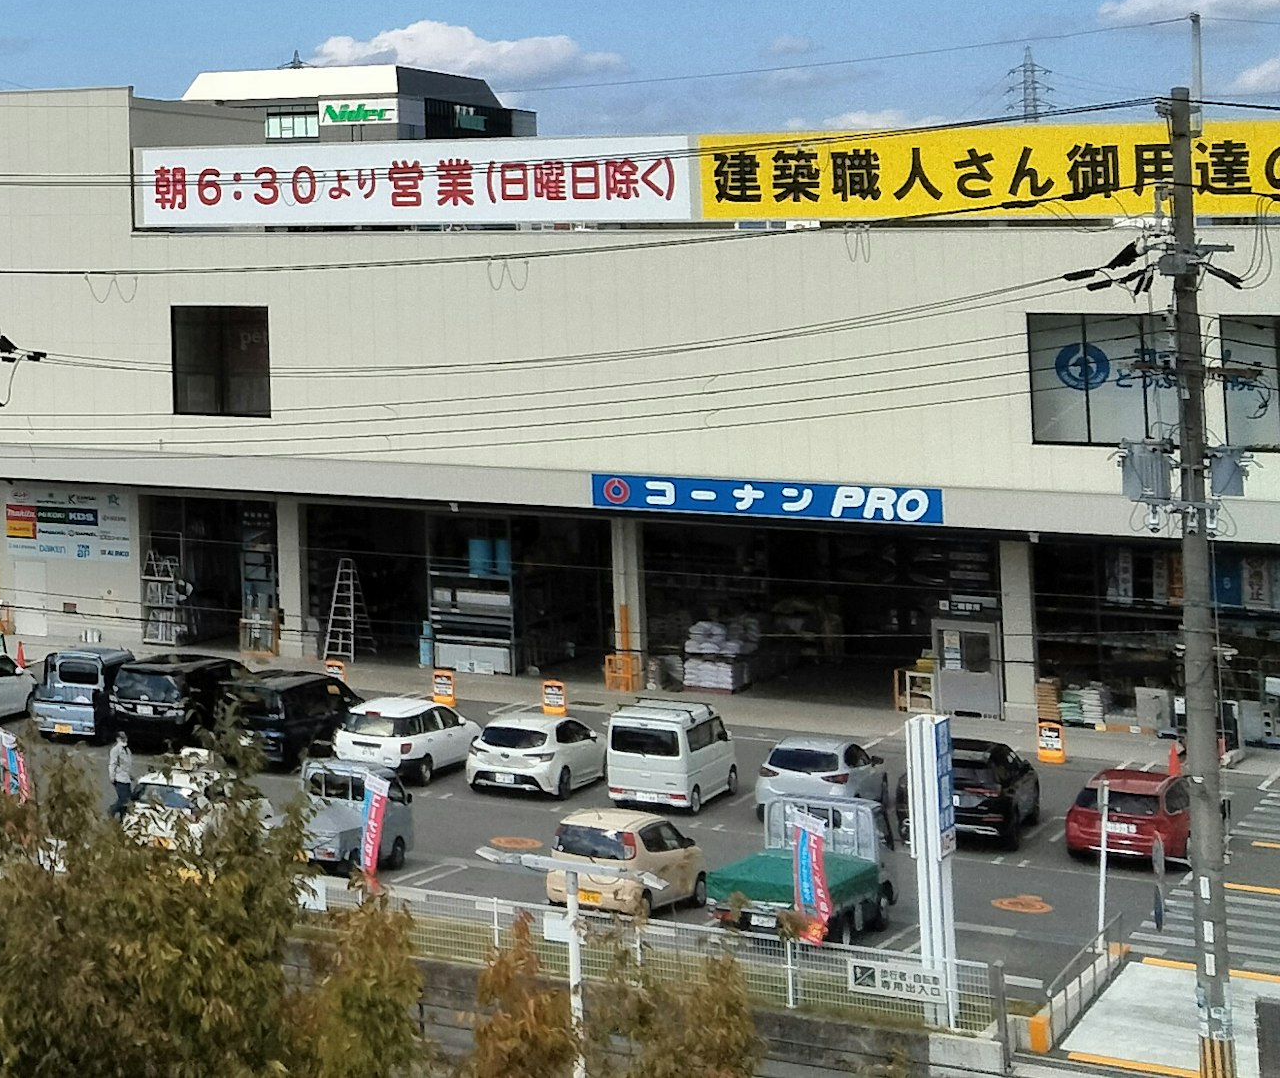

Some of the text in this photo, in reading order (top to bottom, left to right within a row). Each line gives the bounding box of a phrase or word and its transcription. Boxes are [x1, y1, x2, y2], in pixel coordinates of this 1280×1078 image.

[322, 103, 395, 122] Nidec
[645, 480, 929, 521] コーナン PRO
[69, 512, 94, 521] KDS
[881, 980, 941, 997] 専用出入口
